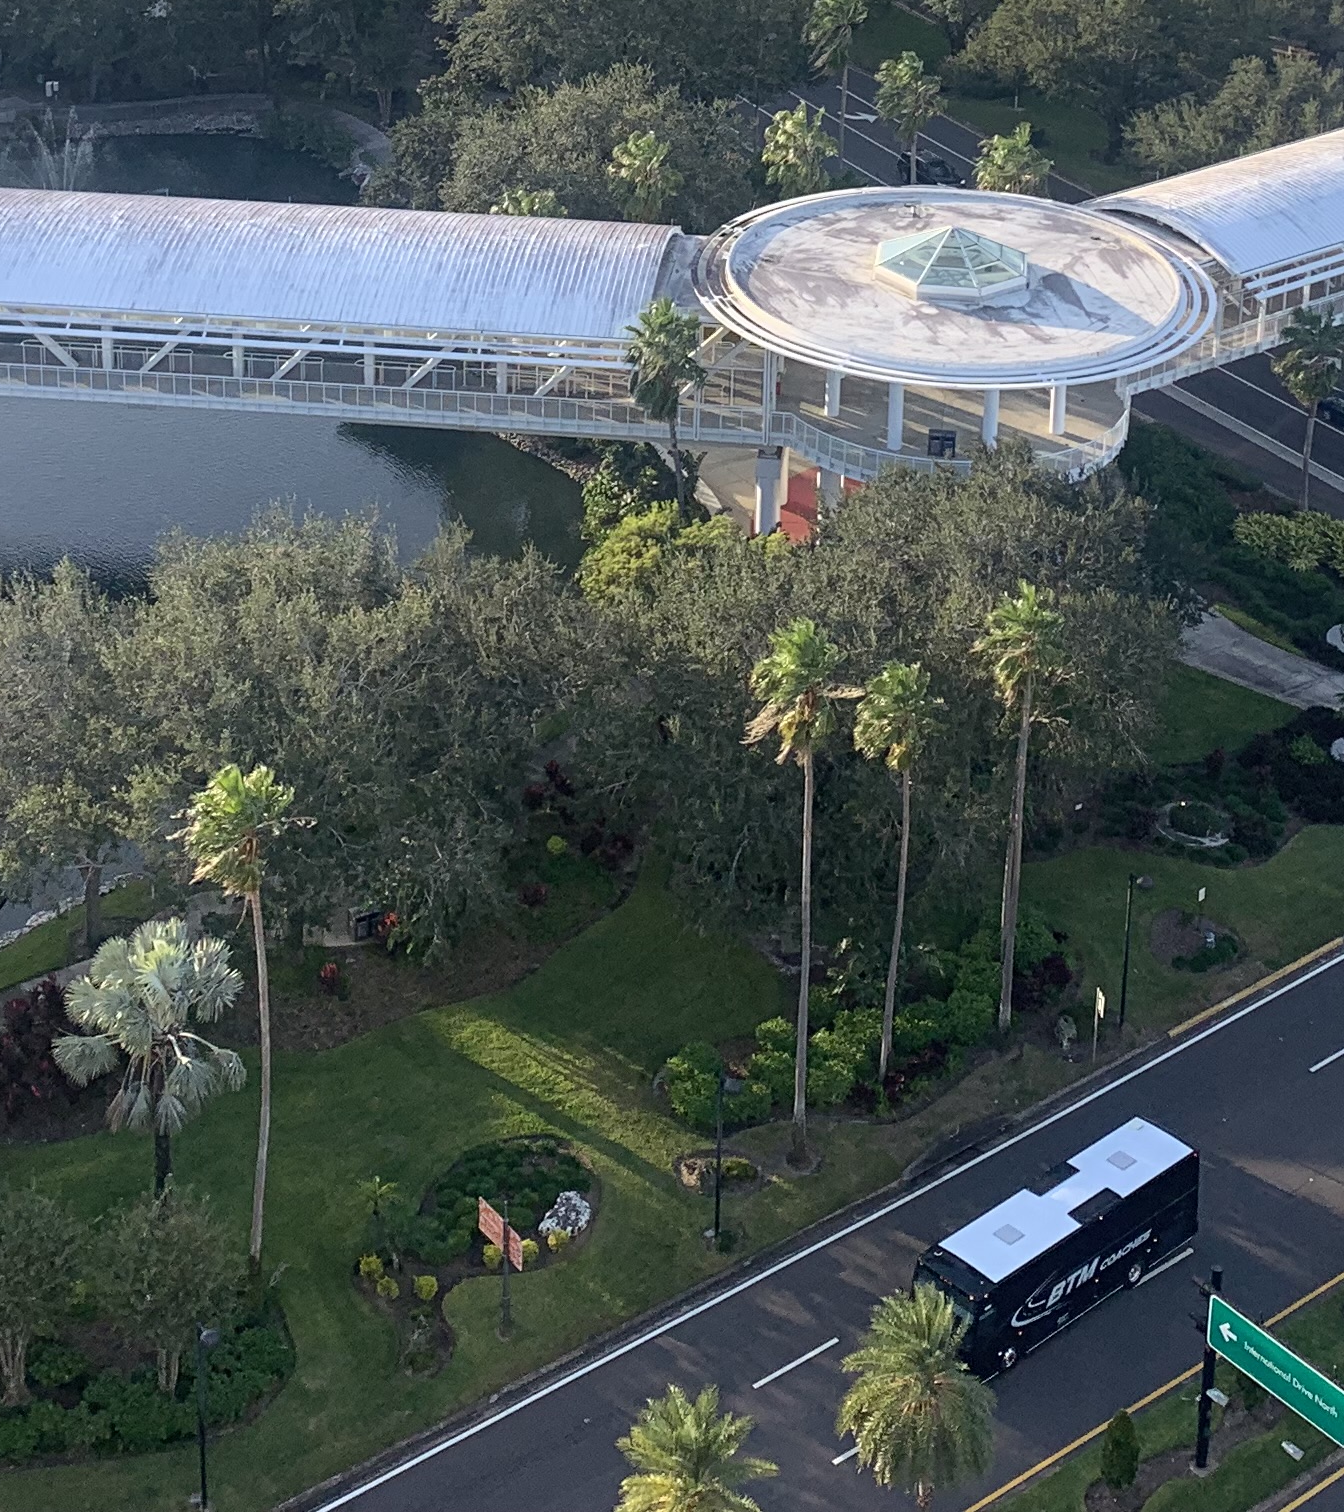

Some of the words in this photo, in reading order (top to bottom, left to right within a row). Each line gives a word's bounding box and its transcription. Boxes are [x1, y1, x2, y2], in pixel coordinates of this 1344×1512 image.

[1046, 1255, 1101, 1309] BTM
[1243, 1341, 1292, 1383] International
[1292, 1378, 1313, 1400] Drive
[1314, 1394, 1338, 1418] North
